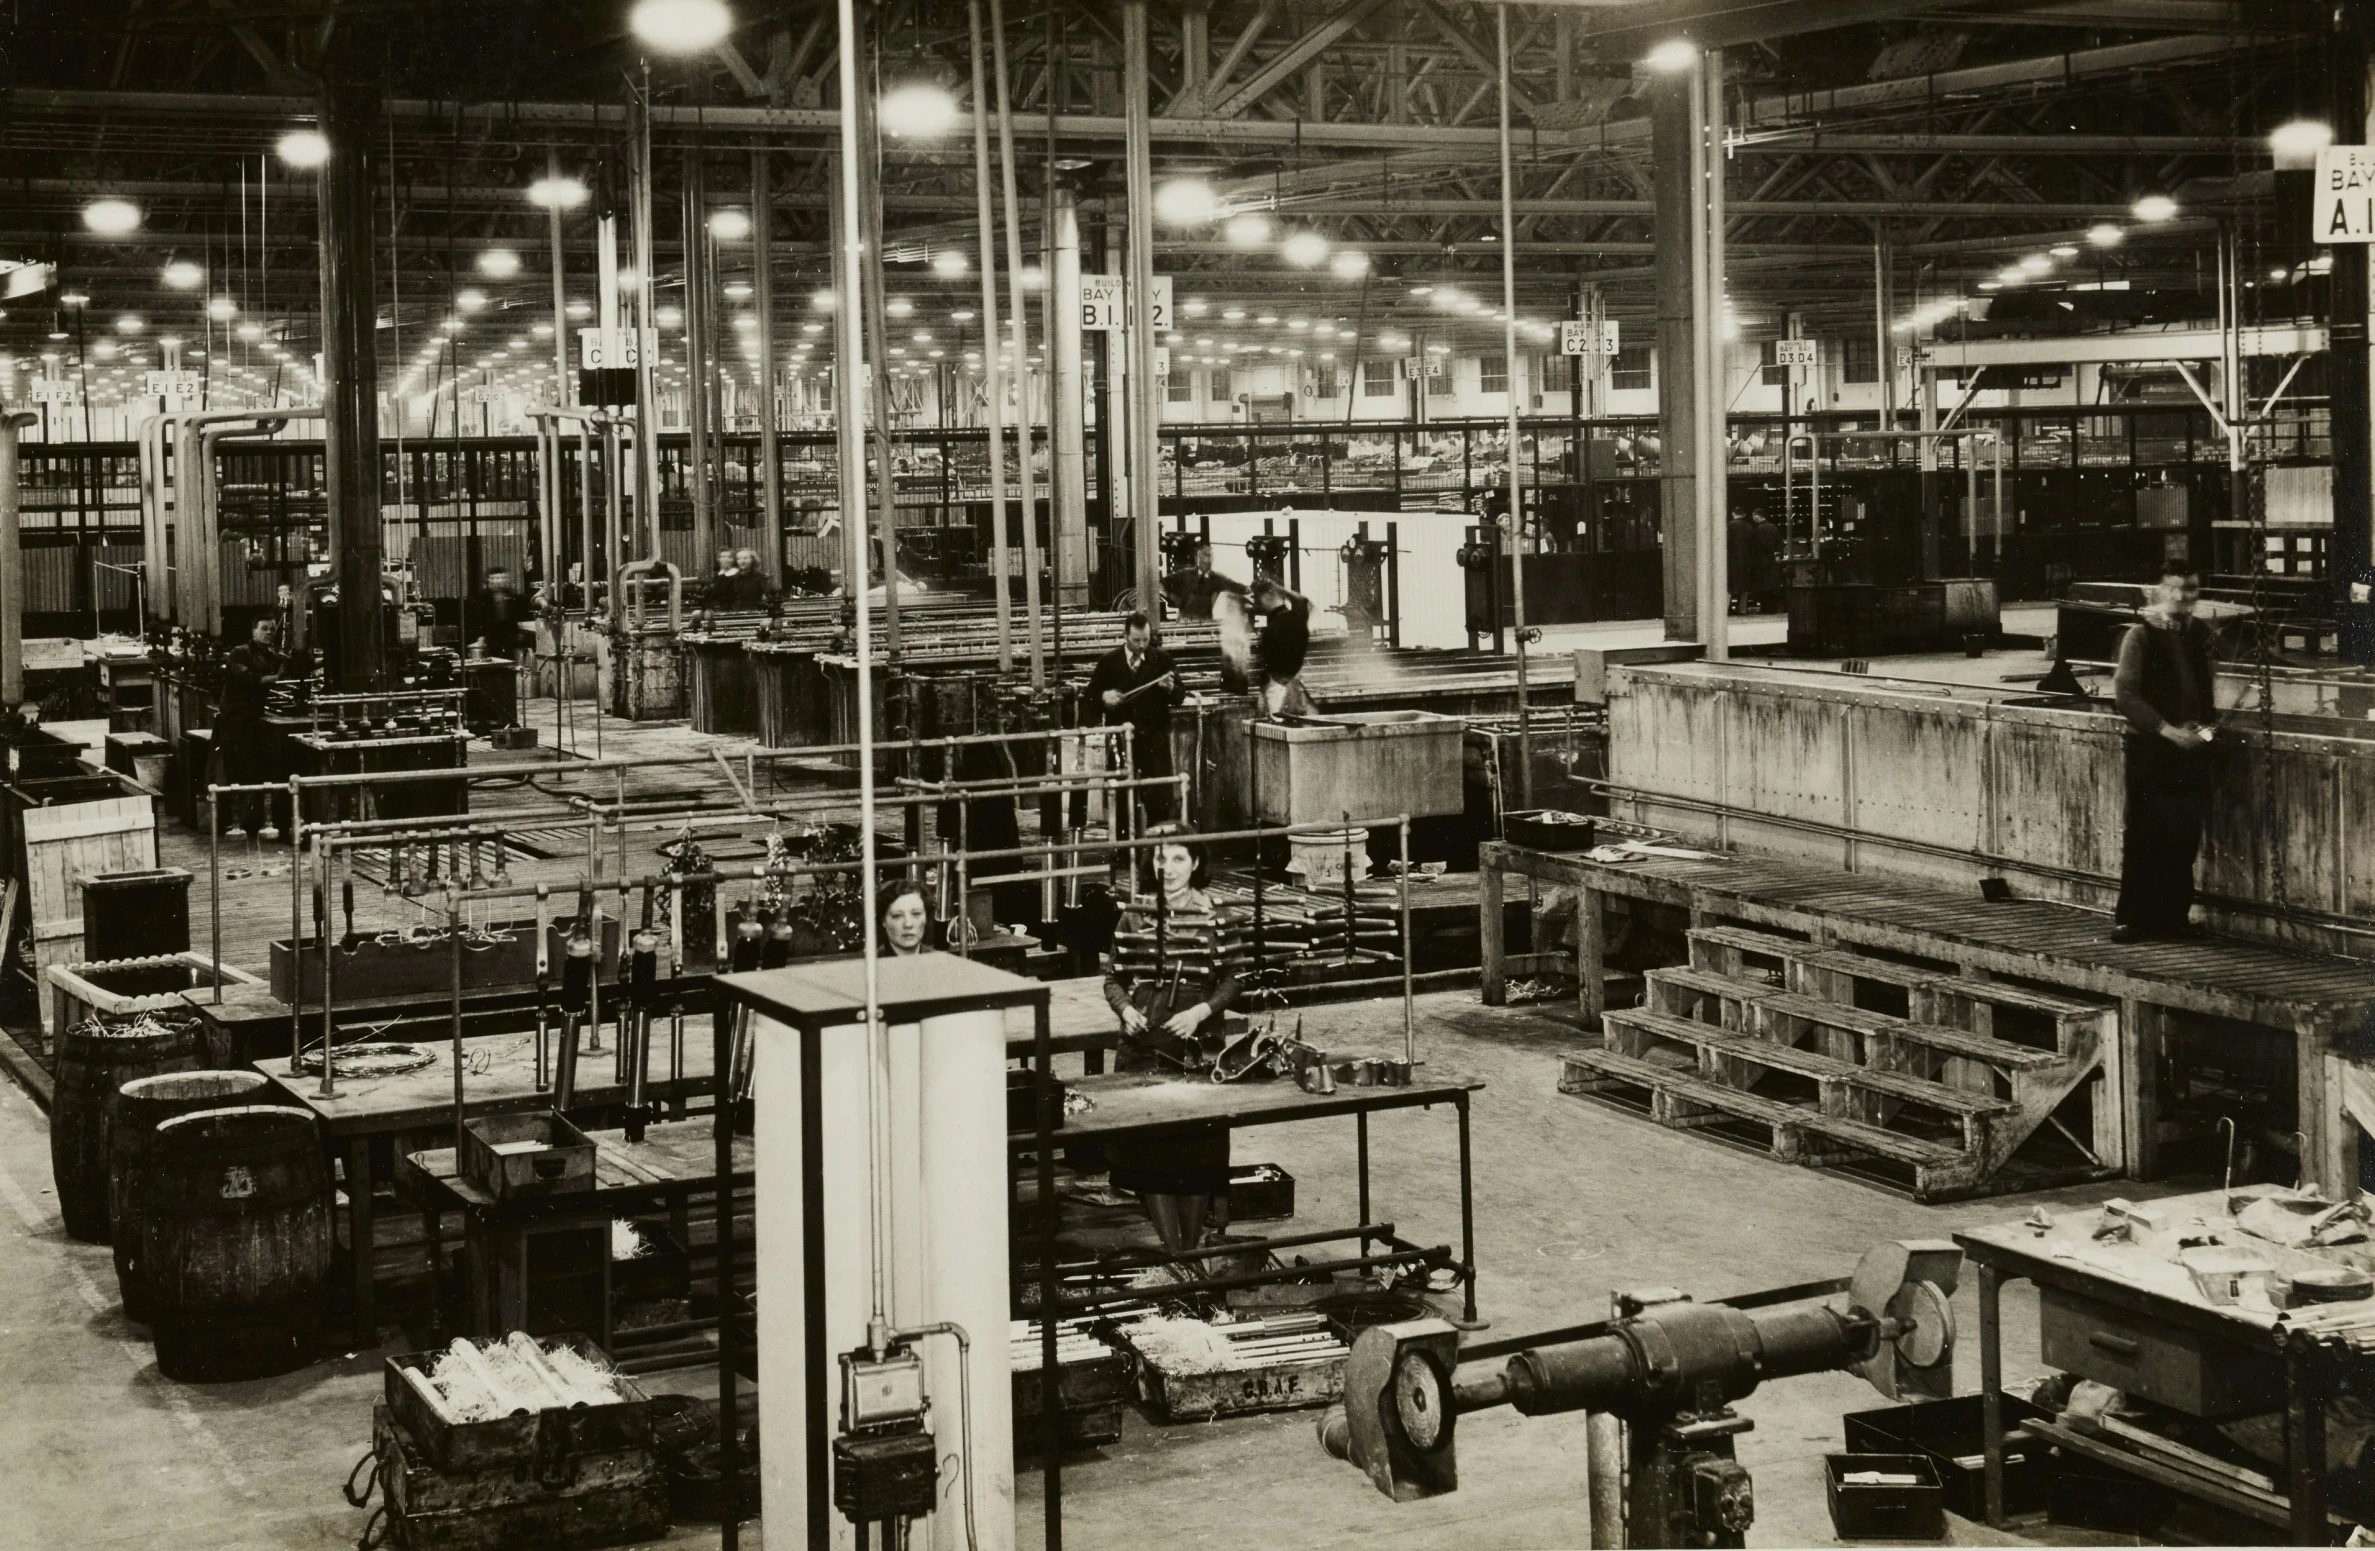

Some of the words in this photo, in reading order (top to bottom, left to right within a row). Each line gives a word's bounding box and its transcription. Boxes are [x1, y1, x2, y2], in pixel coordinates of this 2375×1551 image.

[2332, 169, 2375, 190] BAY
[1083, 288, 1114, 301] BAY
[1567, 328, 1585, 337] BAY
[1408, 367, 1421, 377] E3
[1425, 366, 1438, 376] E4
[176, 383, 194, 394] E2
[56, 391, 71, 400] F2
